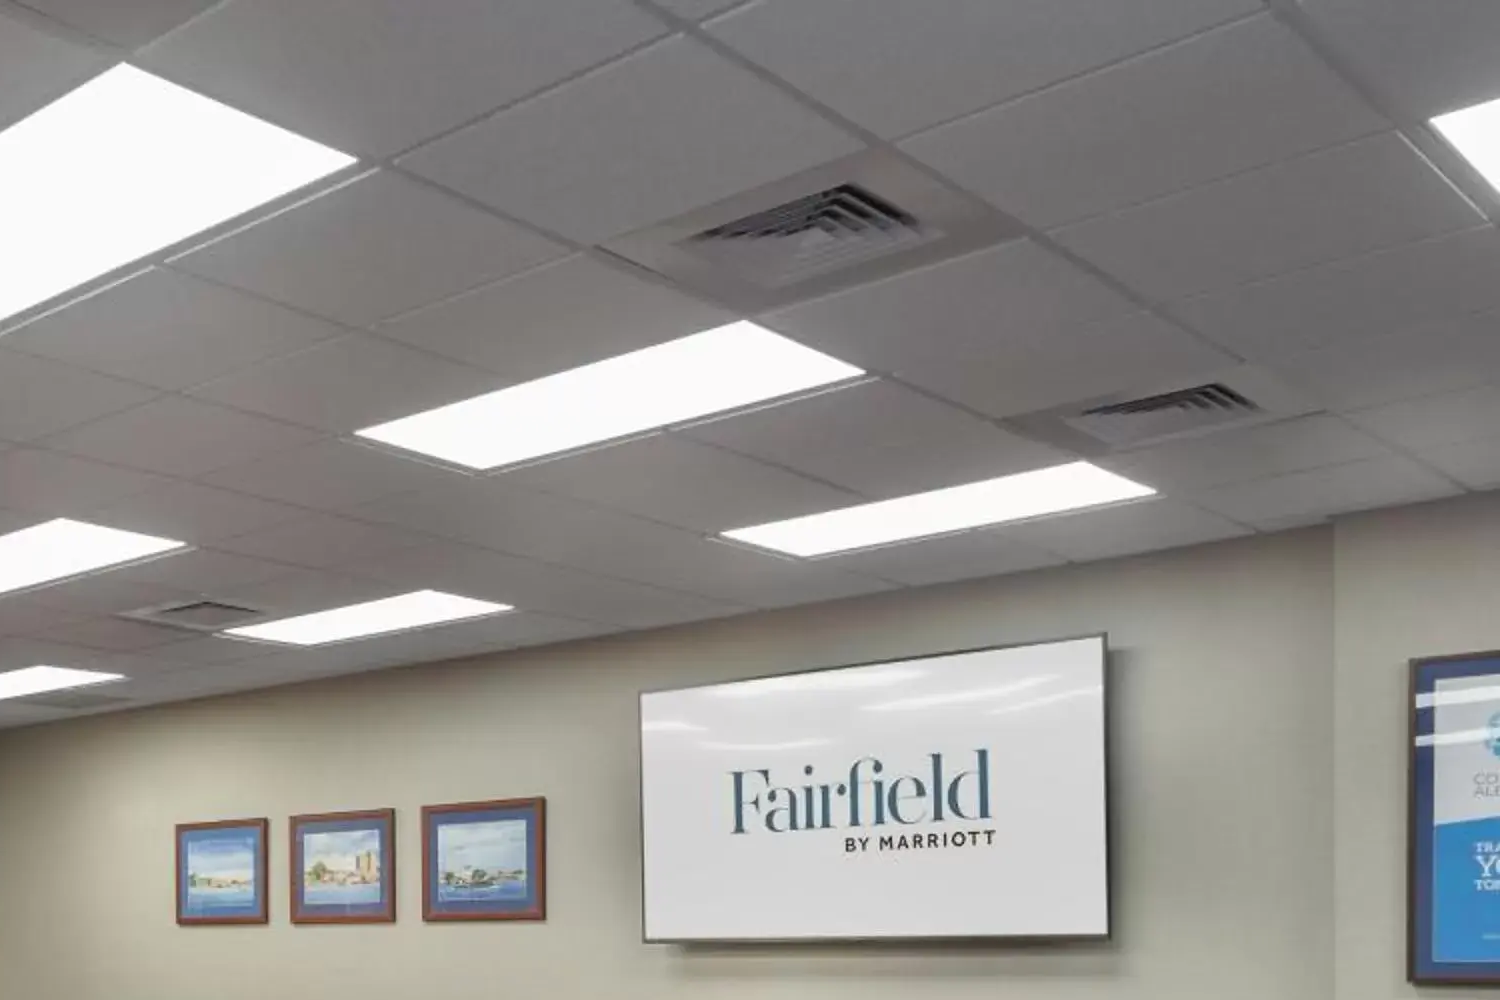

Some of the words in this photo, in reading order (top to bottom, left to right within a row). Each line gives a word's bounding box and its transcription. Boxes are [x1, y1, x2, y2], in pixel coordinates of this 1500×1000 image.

[727, 748, 993, 834] Fairfield
[845, 836, 870, 853] BY
[879, 829, 996, 851] MARRIOTT
